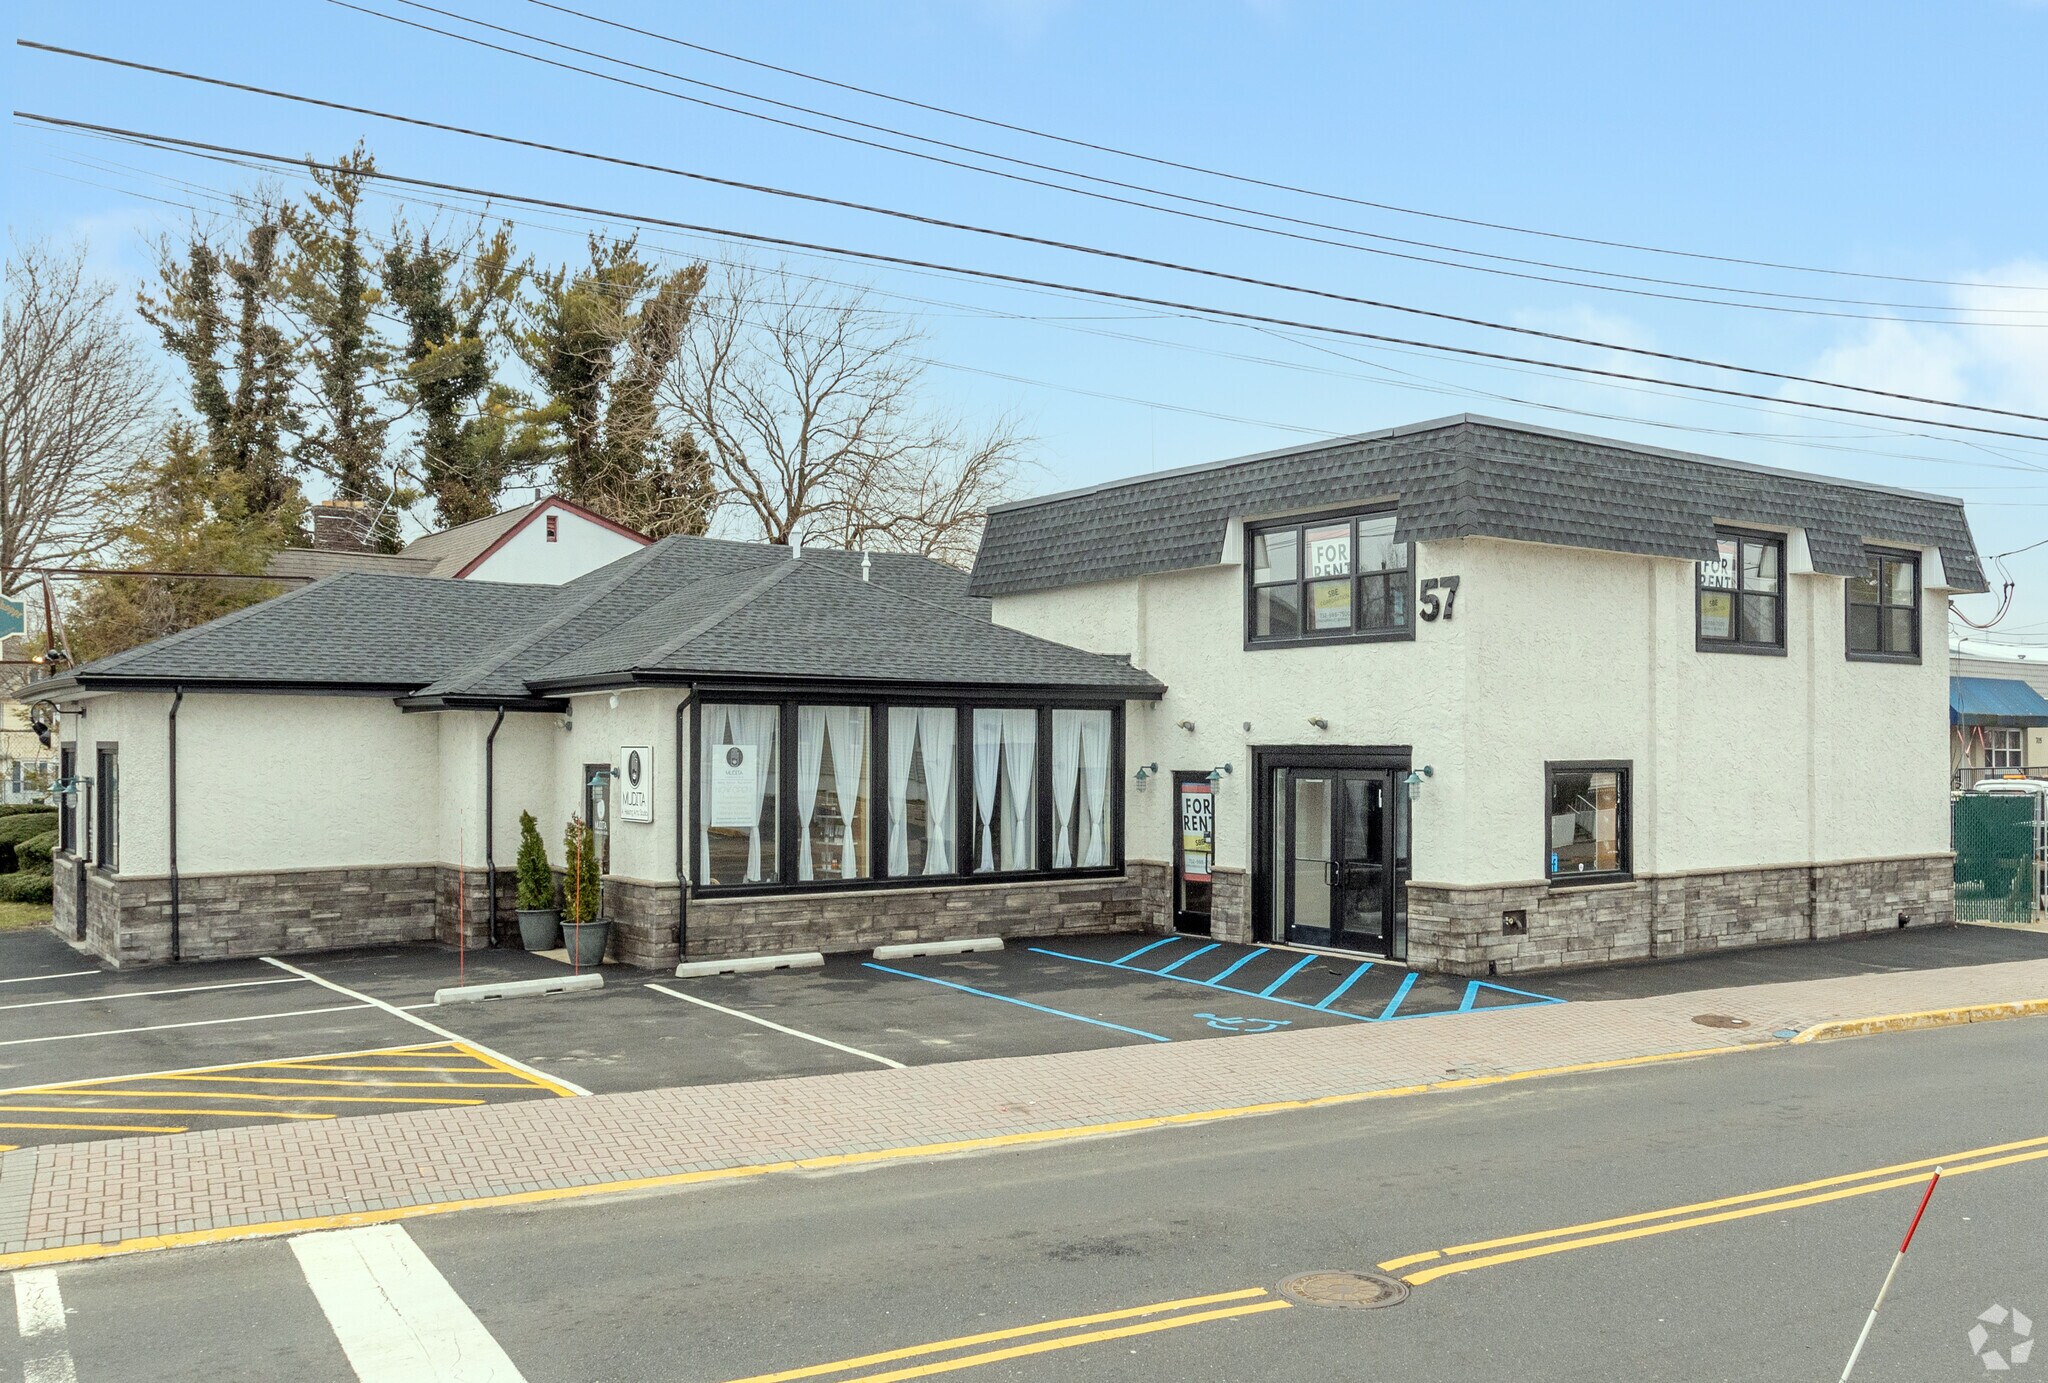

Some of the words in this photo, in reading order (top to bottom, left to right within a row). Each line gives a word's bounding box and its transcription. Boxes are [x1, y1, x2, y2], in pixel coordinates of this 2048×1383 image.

[1316, 544, 1348, 564] FOR
[1704, 559, 1728, 575] FOR
[1328, 588, 1339, 598] SBE
[1419, 575, 1460, 622] 57
[622, 791, 647, 807] MUDITA
[1185, 798, 1212, 814] FOR
[1184, 815, 1212, 831] REN
